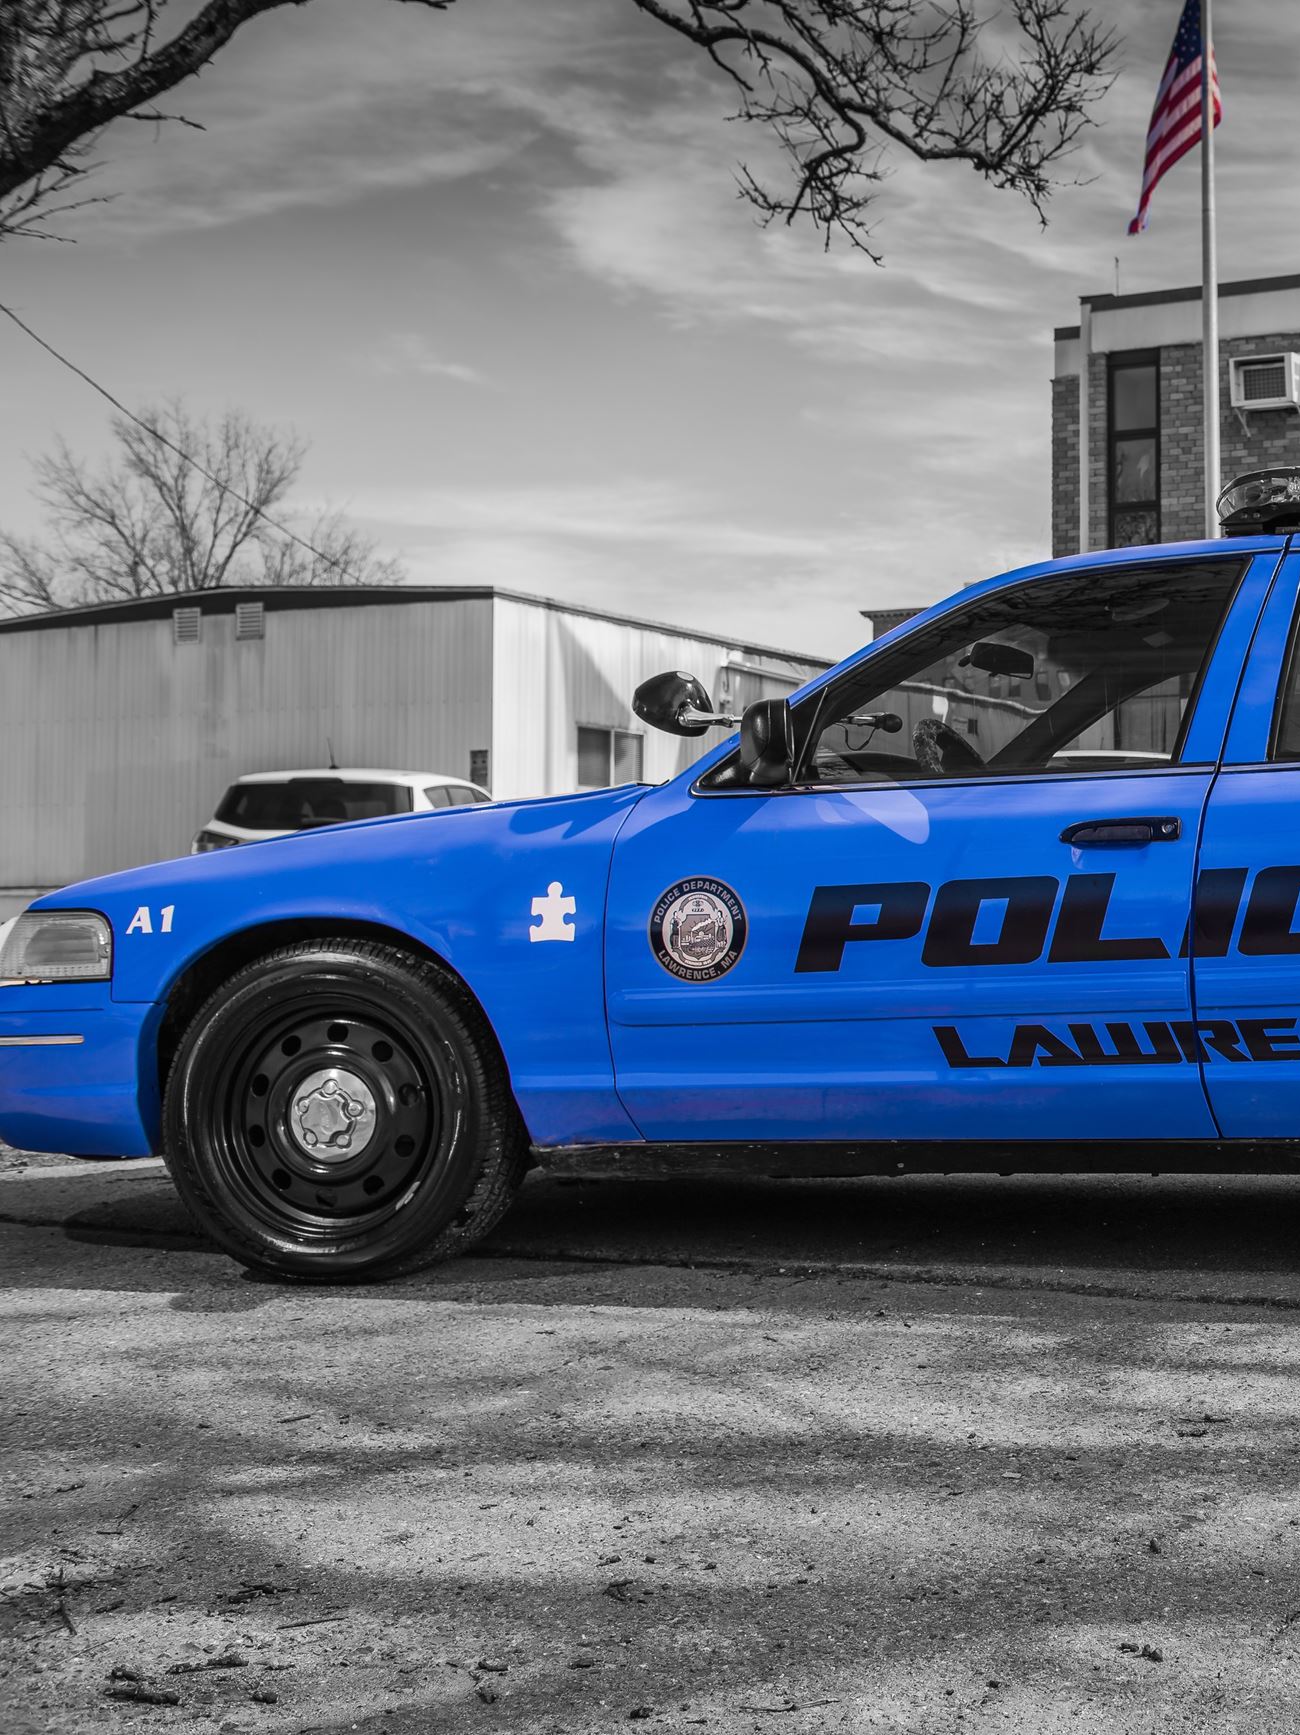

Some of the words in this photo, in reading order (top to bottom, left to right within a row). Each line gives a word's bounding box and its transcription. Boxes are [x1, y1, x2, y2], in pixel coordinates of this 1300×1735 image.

[654, 888, 681, 924] POLICE
[682, 880, 742, 921] DEPARTMENT
[125, 904, 175, 935] A1
[721, 950, 738, 969] MA
